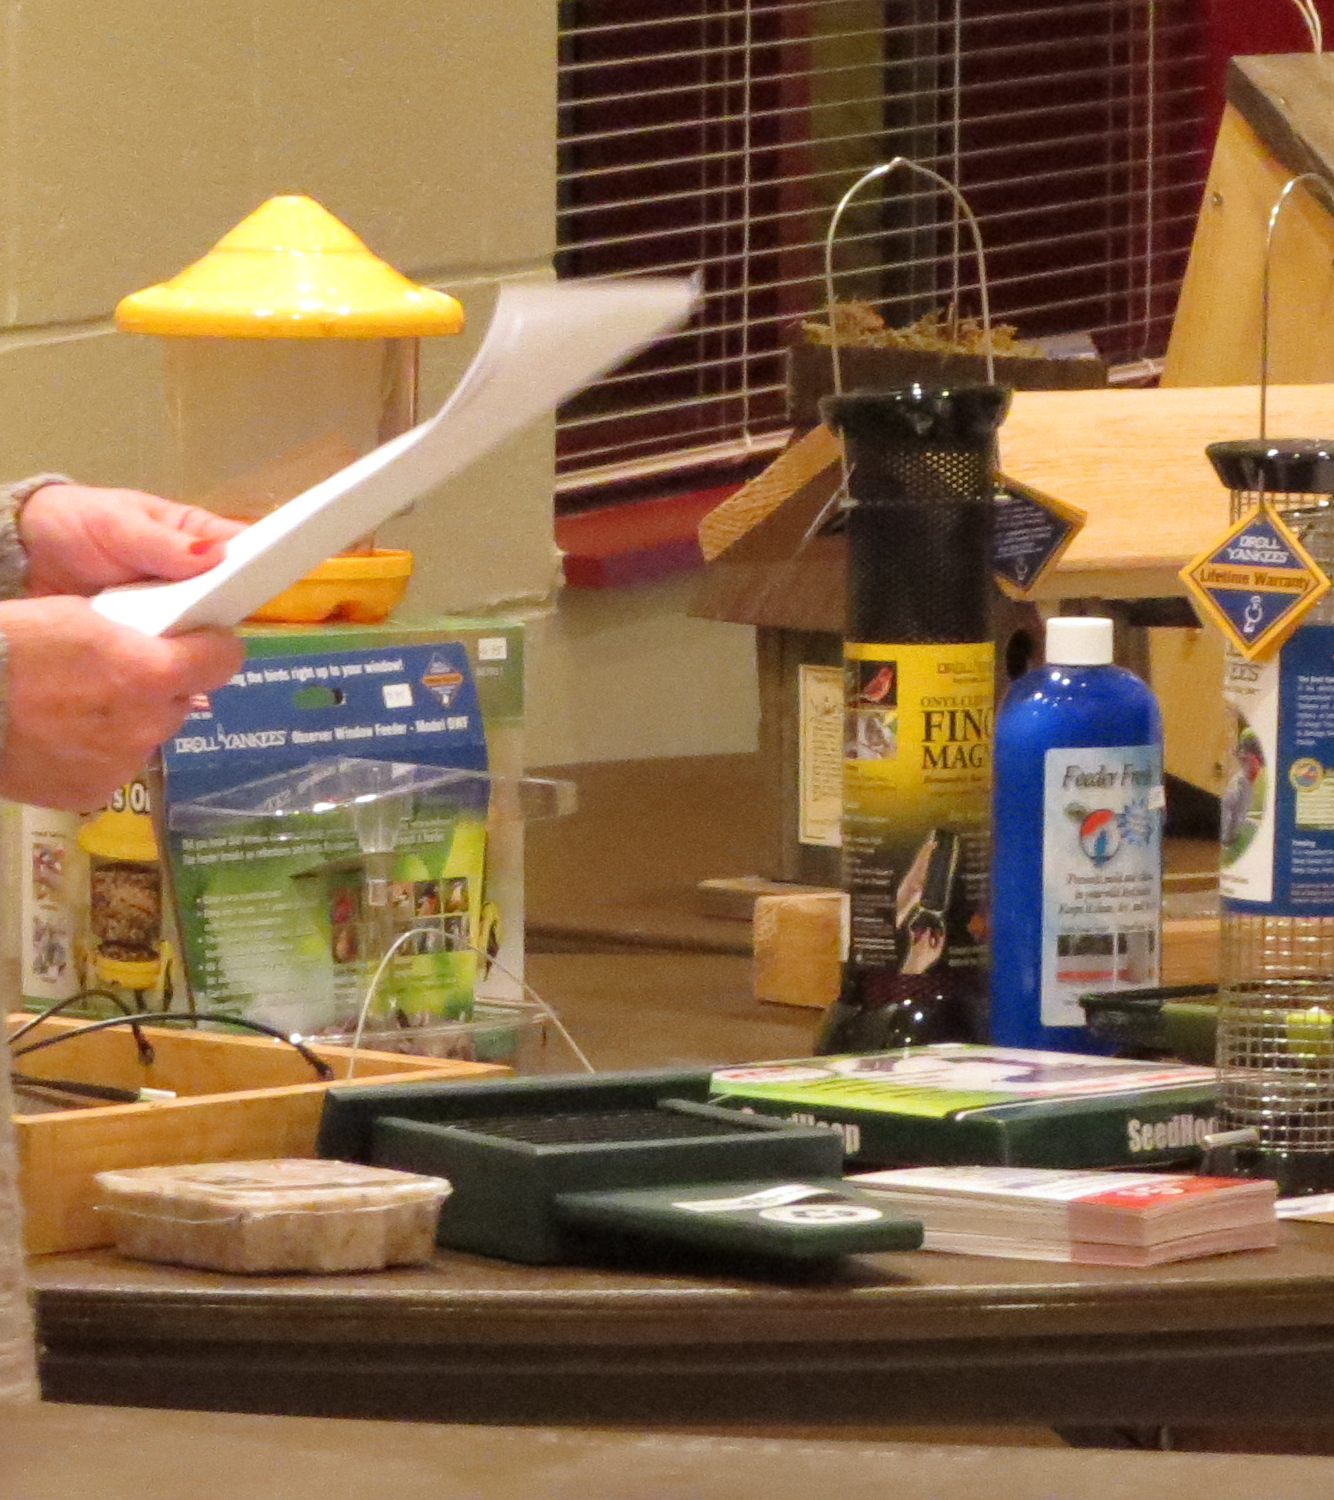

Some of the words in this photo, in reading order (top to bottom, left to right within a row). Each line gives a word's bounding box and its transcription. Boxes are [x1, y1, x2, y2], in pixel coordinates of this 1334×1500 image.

[1239, 536, 1281, 549] DROLL
[1227, 550, 1289, 564] YANKEES
[1199, 567, 1250, 584] Lifetime
[1254, 572, 1311, 590] Warranty
[264, 668, 291, 681] birds
[291, 666, 316, 682] right
[342, 663, 363, 678] your
[174, 736, 219, 753] DROLL
[221, 730, 287, 750] YANKEES
[335, 725, 374, 740] Window
[375, 722, 408, 737] Feeder
[415, 718, 446, 733] Model
[921, 744, 991, 769] MAG
[1063, 764, 1114, 788] Feeder
[1128, 1114, 1219, 1152] SeedHoo
